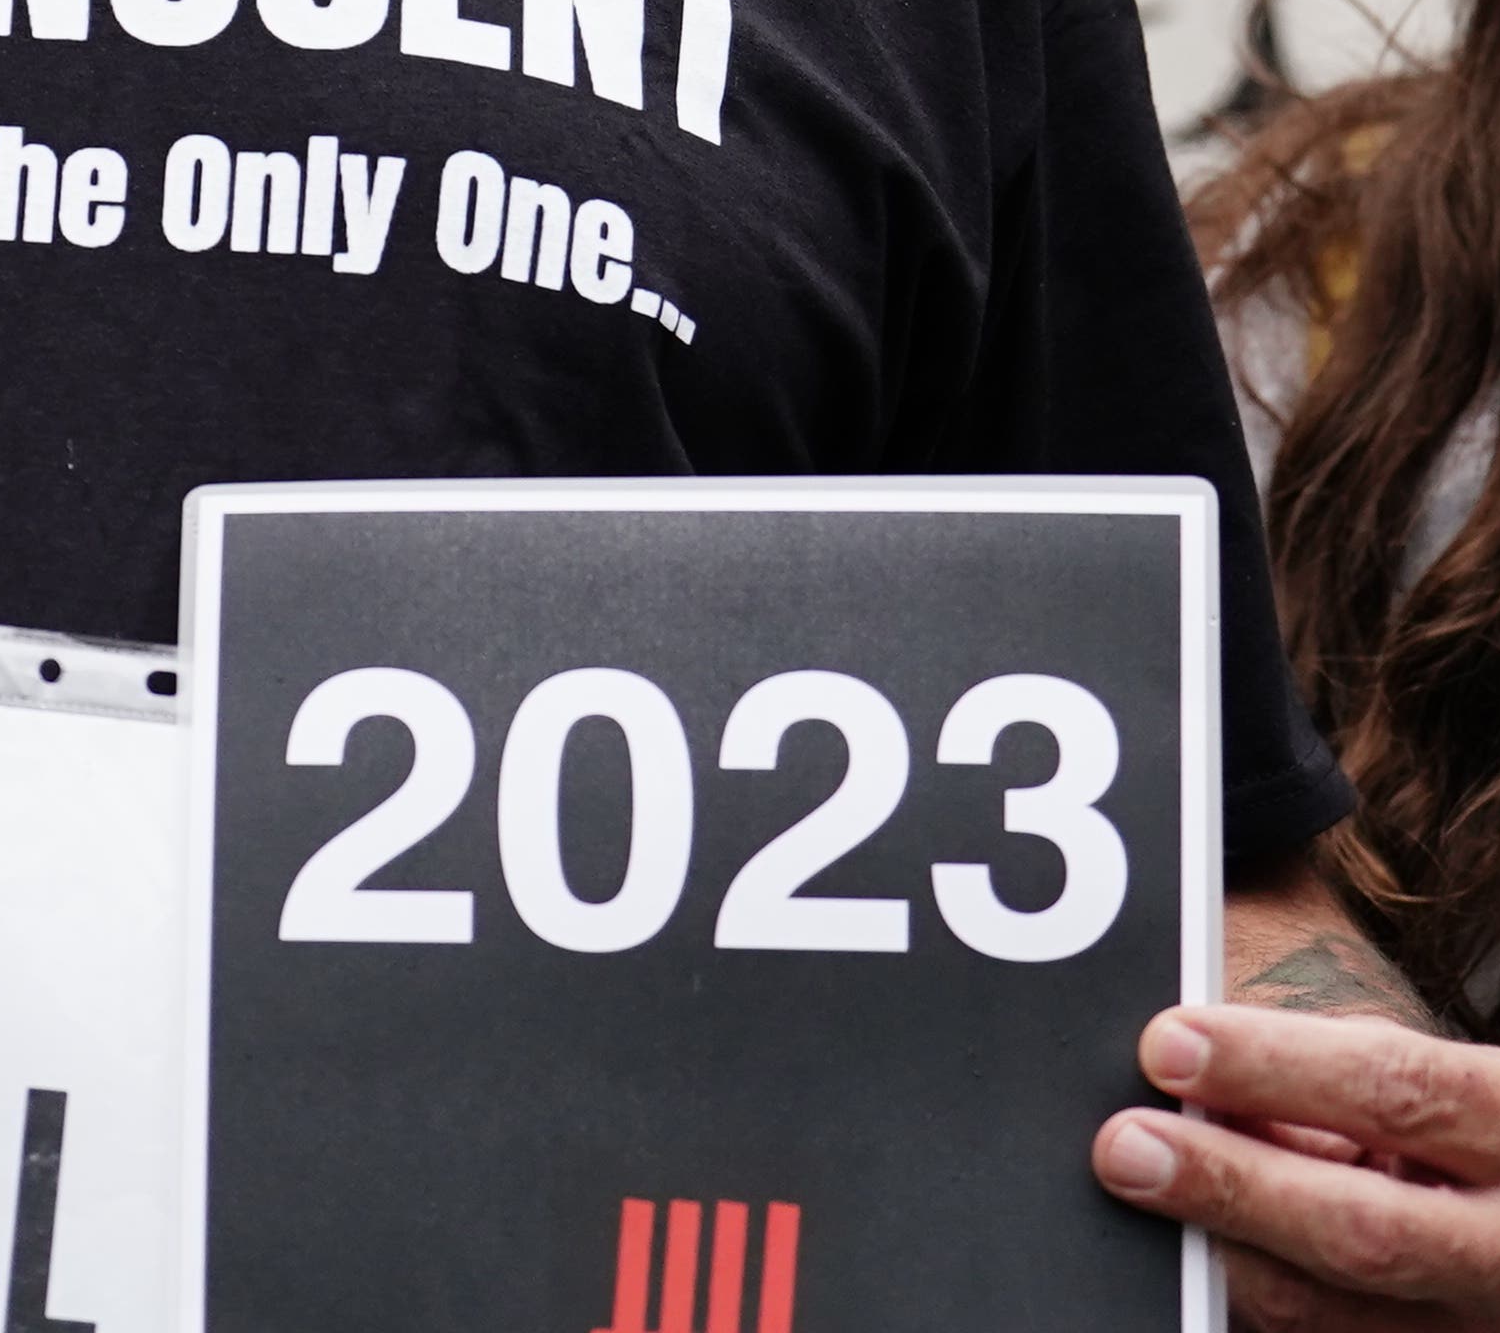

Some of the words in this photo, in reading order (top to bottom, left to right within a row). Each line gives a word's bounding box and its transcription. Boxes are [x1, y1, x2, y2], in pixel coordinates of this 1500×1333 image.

[162, 134, 407, 275] Only
[435, 150, 697, 345] One...
[278, 666, 1128, 963] 2023
